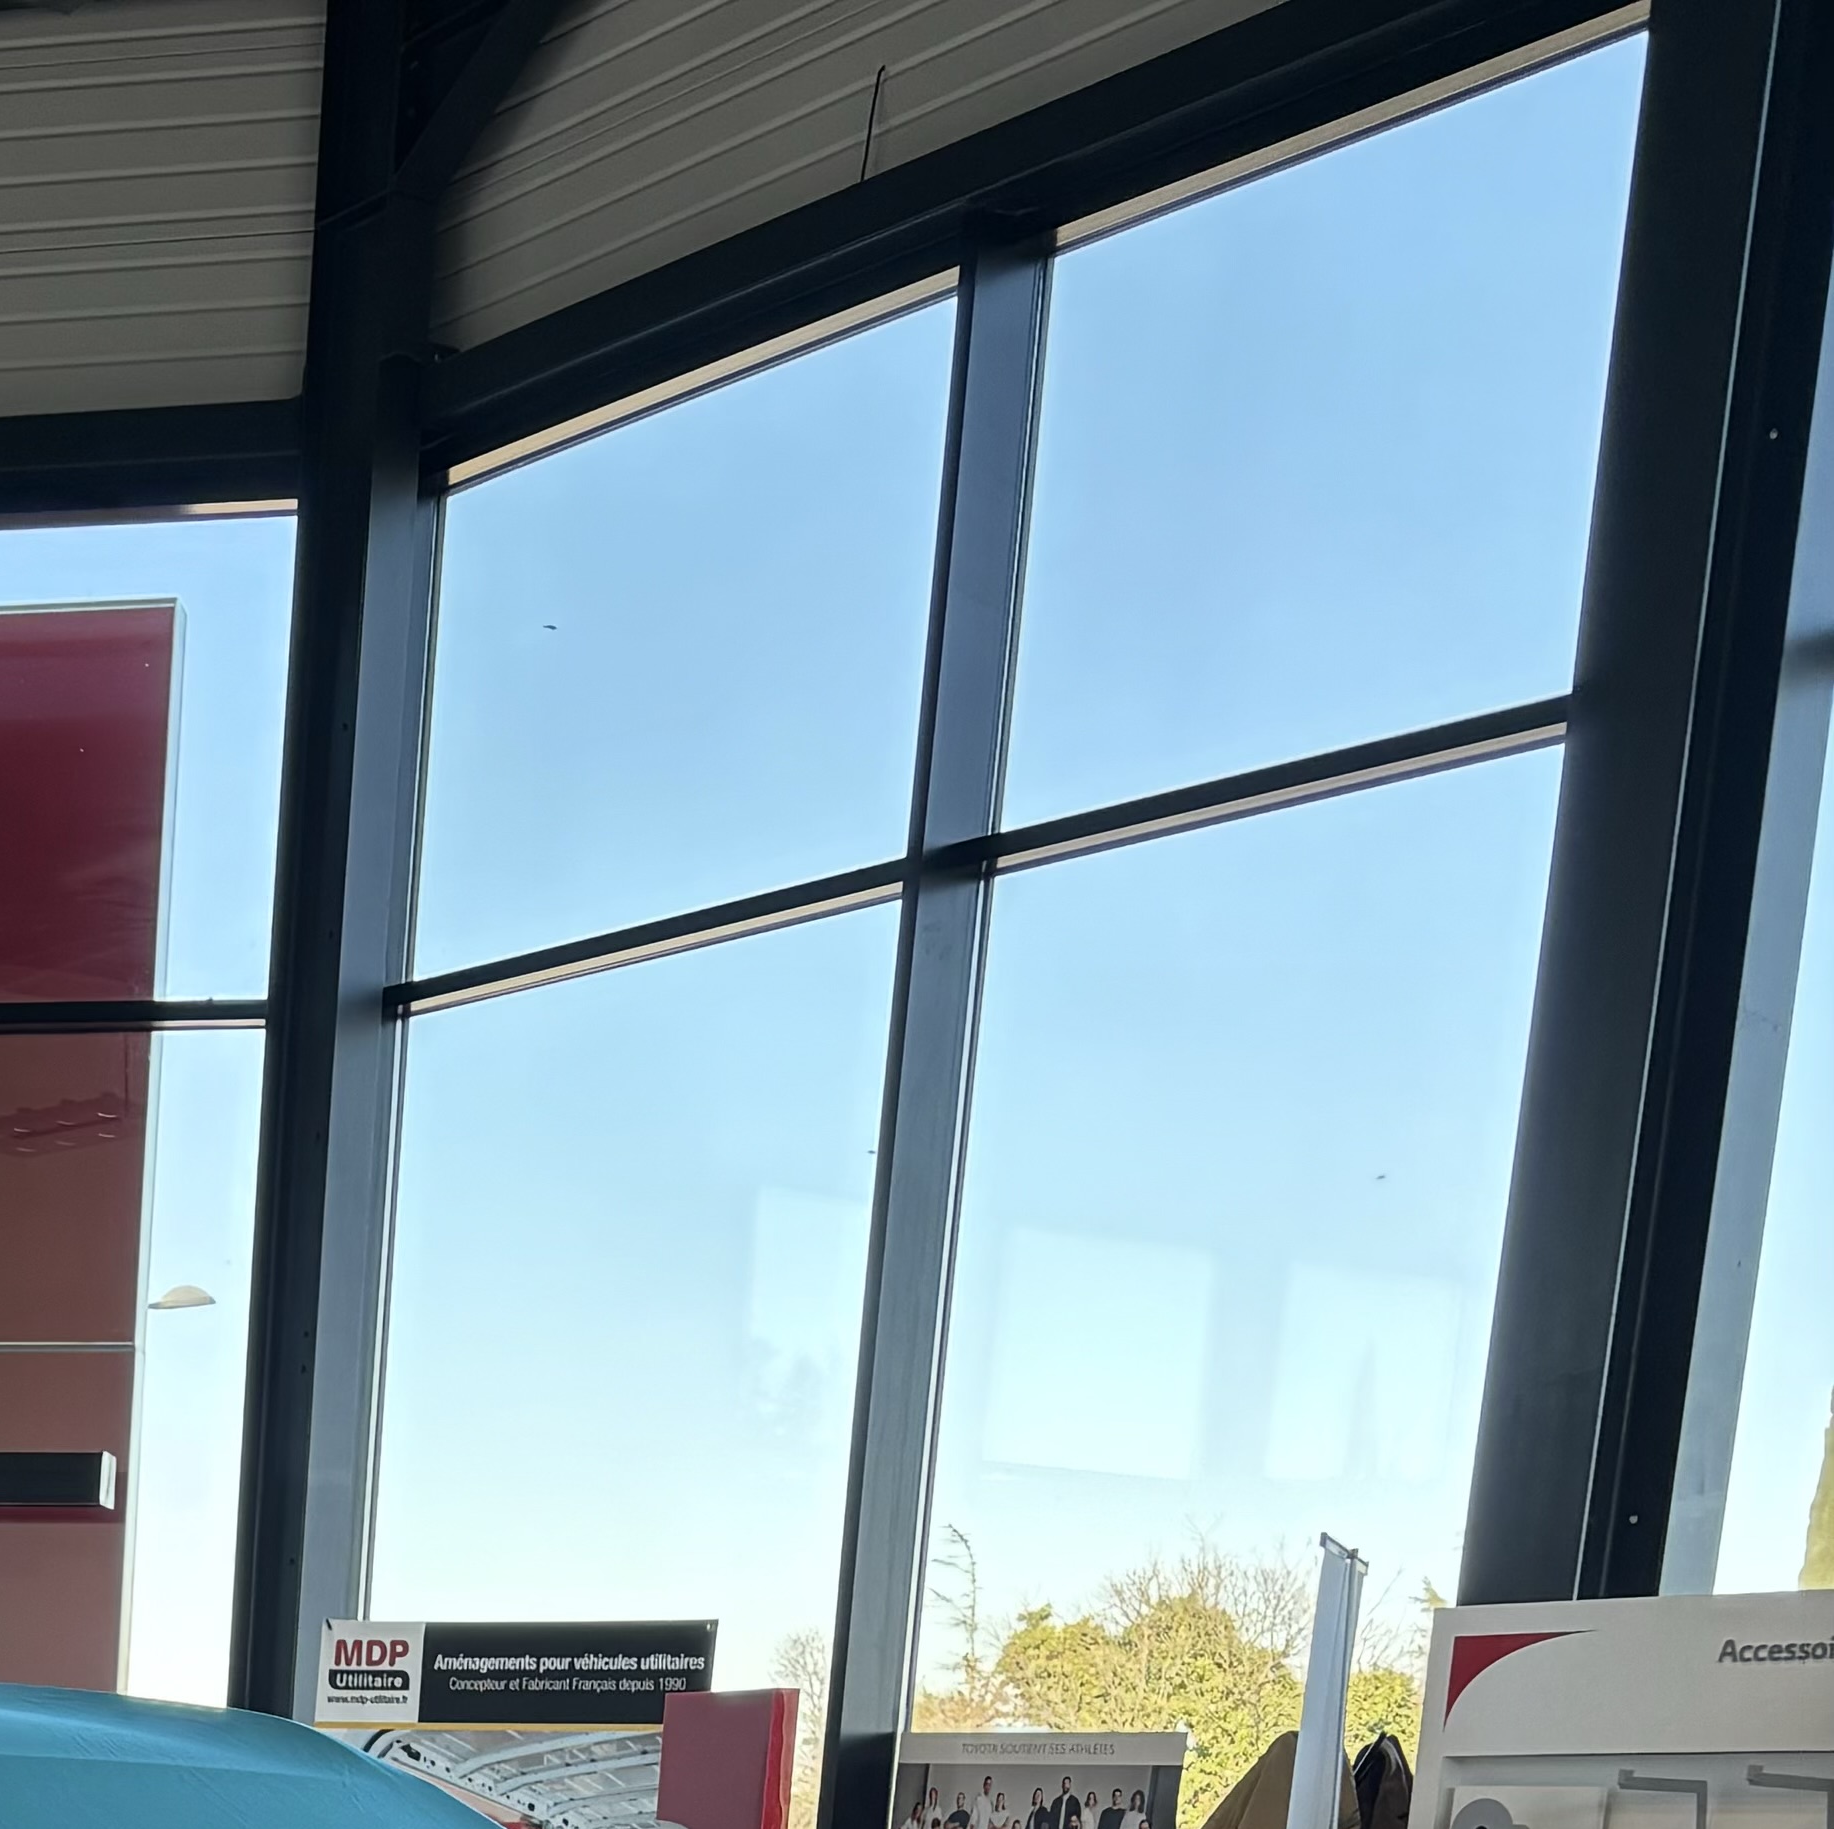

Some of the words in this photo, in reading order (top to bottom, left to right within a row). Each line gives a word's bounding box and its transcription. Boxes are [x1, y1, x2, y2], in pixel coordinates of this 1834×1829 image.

[334, 1639, 410, 1667] MDP
[433, 1653, 537, 1673] Aménagements
[539, 1657, 572, 1673] pour
[573, 1654, 637, 1671] véhicules
[640, 1654, 705, 1671] utilitaires
[335, 1673, 403, 1688] Utilitaire
[449, 1677, 507, 1692] Concepteur
[509, 1677, 520, 1691] et
[522, 1676, 570, 1691] Fabricant
[572, 1677, 616, 1695] Français
[619, 1676, 654, 1694] depuis
[658, 1677, 687, 1691] 1990
